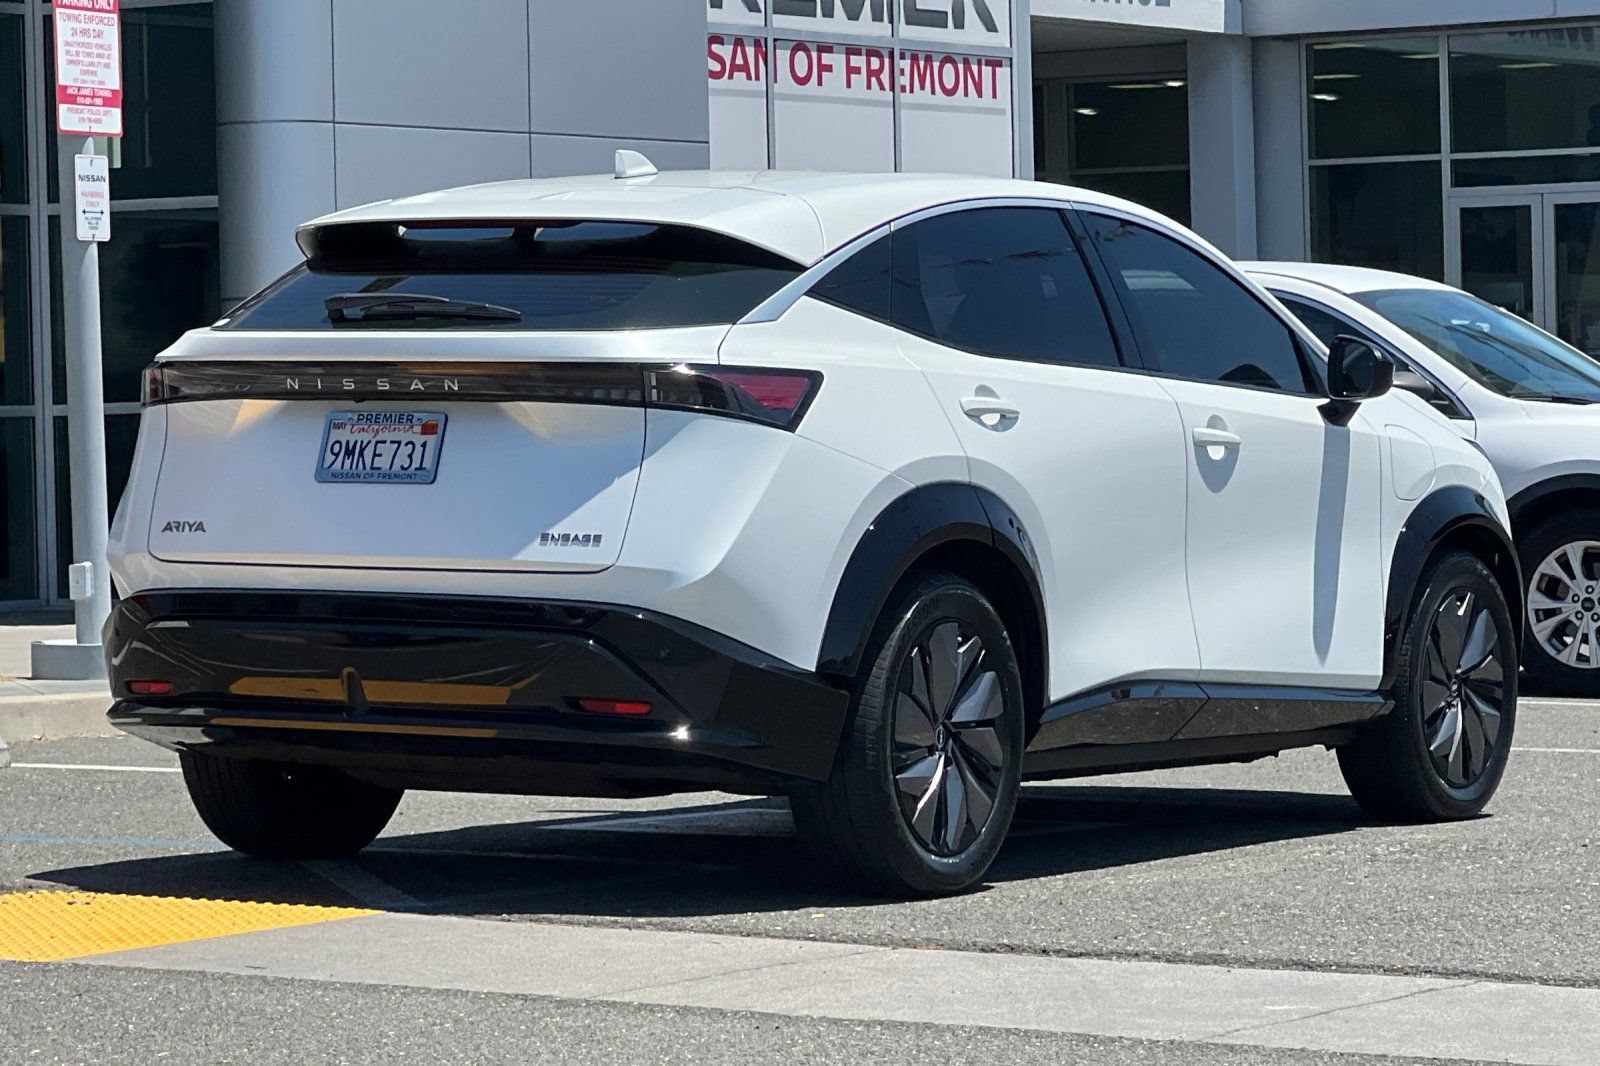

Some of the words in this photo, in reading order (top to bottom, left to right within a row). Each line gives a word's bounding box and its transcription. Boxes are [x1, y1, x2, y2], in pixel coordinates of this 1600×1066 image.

[59, 12, 82, 24] TOWING
[84, 14, 115, 27] ENFORCED
[71, 27, 78, 37] 24
[79, 28, 91, 38] HRS
[93, 29, 104, 39] DAY
[789, 42, 833, 86] OF
[845, 47, 1003, 99] FREMONT
[78, 174, 106, 182] NISSAN
[81, 191, 104, 199] PARKING
[286, 378, 459, 391] NISSAN
[356, 413, 415, 424] PREMIER
[332, 421, 347, 430] MAY
[350, 424, 415, 438] California
[327, 440, 428, 471] 9MKE731
[376, 472, 418, 480] FREMONT
[161, 520, 206, 533] ARIYA
[540, 533, 602, 544] ENGAGE
